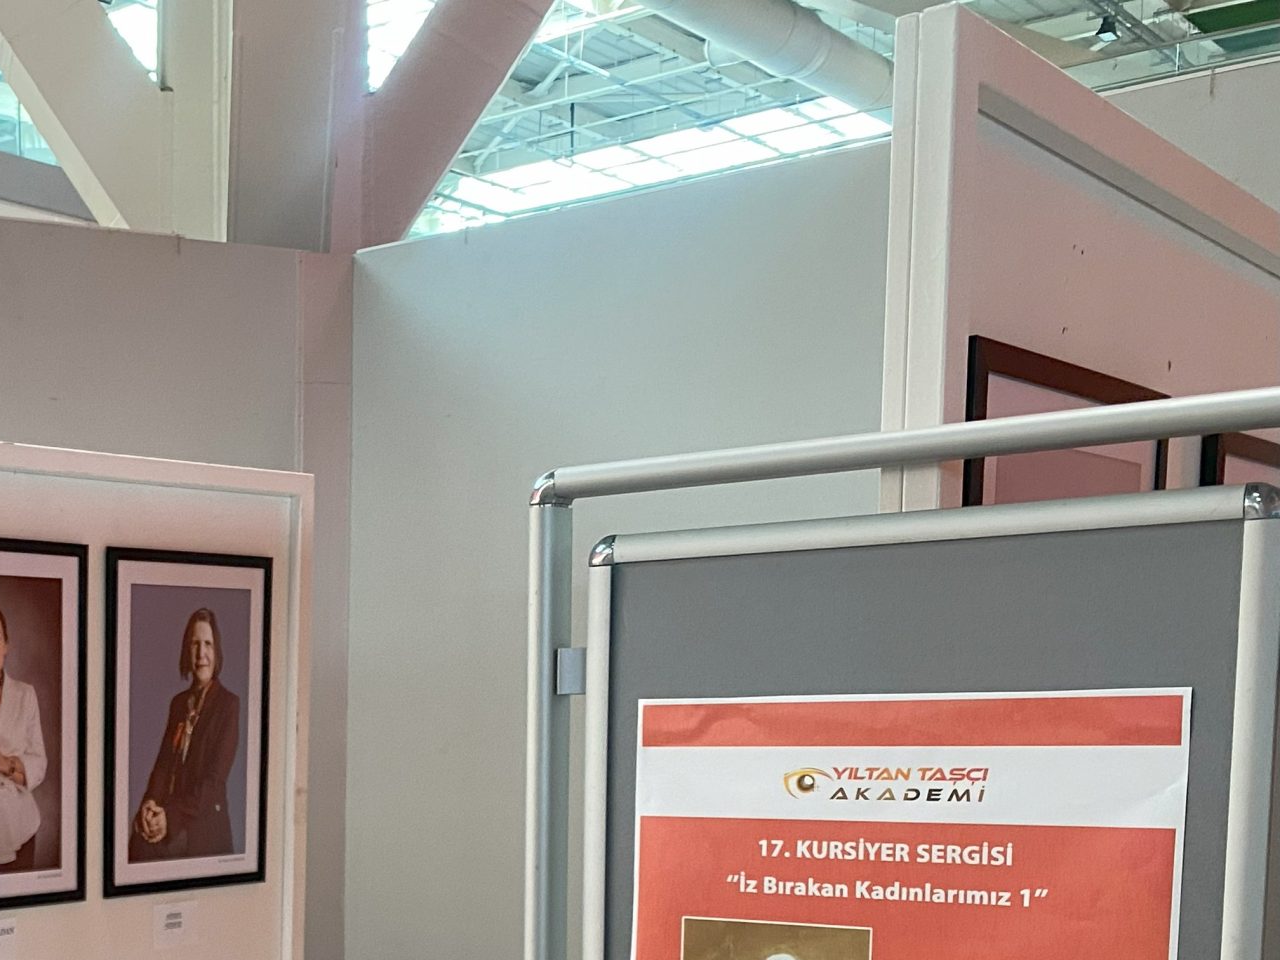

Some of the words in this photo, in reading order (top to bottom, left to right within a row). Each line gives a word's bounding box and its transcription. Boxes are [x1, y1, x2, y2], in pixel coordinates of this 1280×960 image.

[832, 767, 911, 781] YILTAN
[917, 768, 989, 786] TAŞÇI
[830, 785, 985, 803] AKADEMİ
[758, 839, 790, 858] 17.
[796, 838, 909, 862] KURSİYER
[916, 842, 1013, 866] SERGİSİ
[763, 876, 848, 898] Bırakan
[855, 880, 1011, 907] Kadınlarımız
